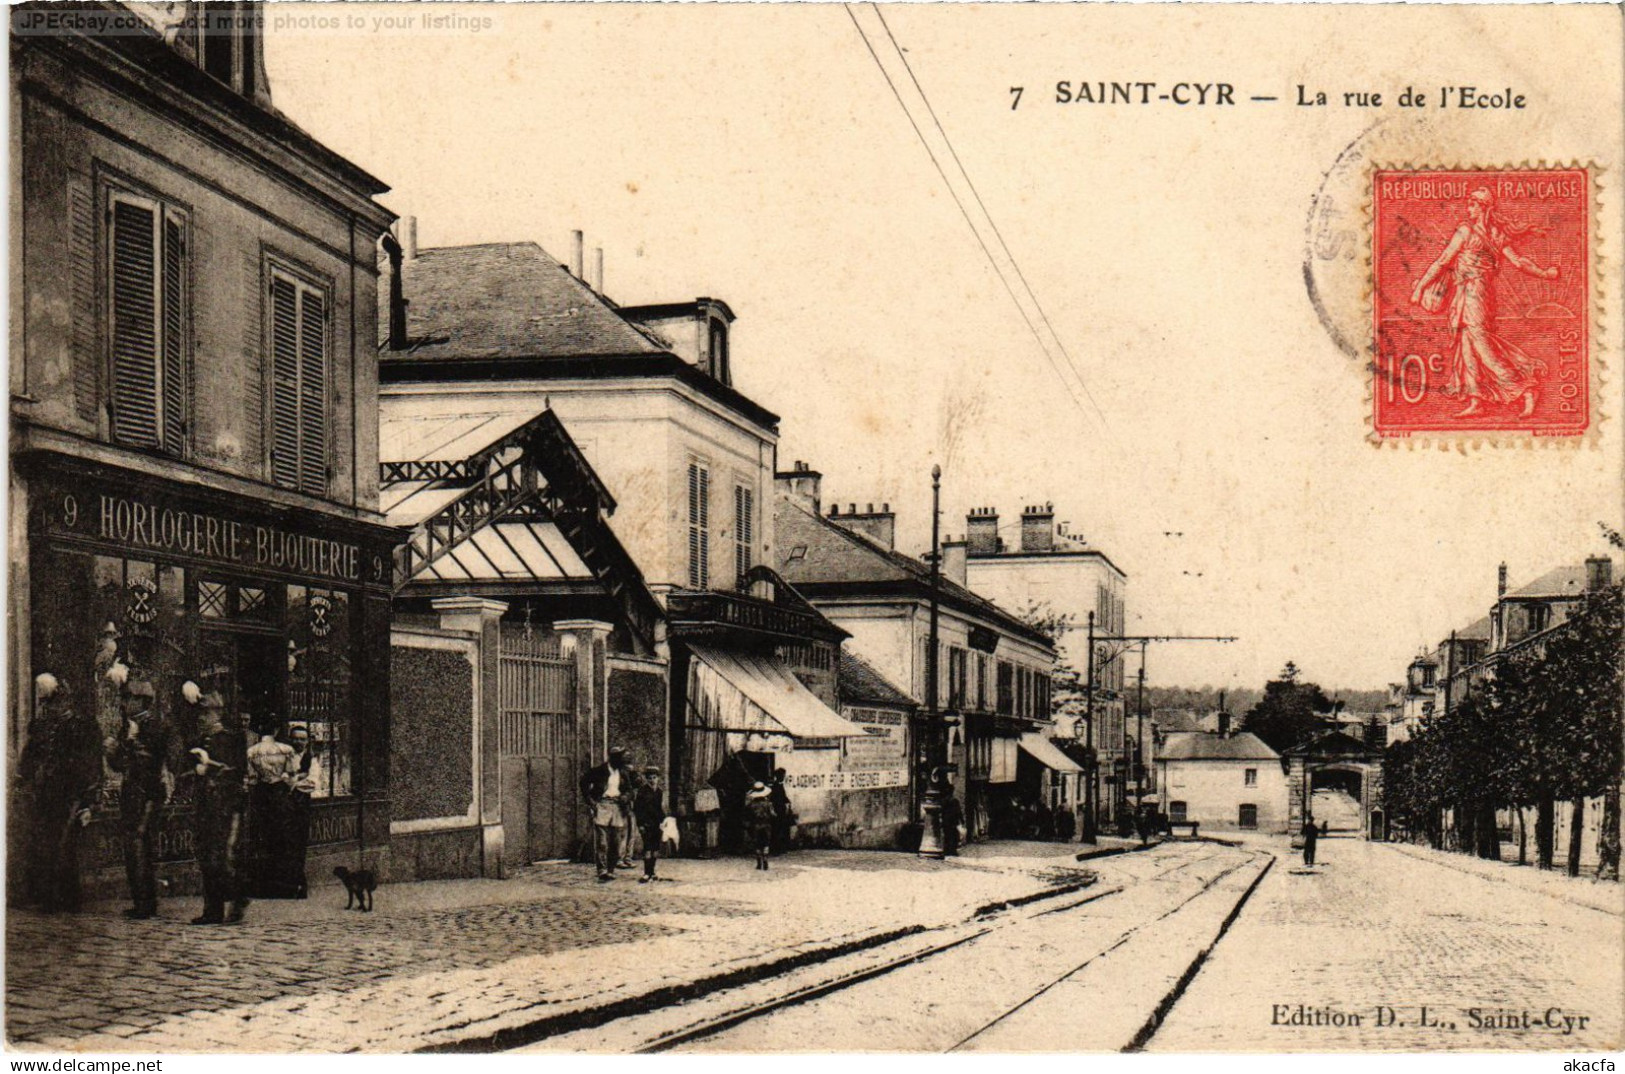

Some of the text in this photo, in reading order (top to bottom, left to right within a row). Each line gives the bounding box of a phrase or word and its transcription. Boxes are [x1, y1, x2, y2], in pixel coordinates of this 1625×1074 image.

[1009, 87, 1024, 111] 7
[1055, 81, 1236, 105] SAINT-CYR
[1297, 84, 1328, 107] La
[1343, 91, 1383, 107] rue
[1397, 86, 1426, 108] de
[1439, 86, 1527, 109] l'Ecole
[1559, 329, 1579, 413] POSTES
[63, 495, 384, 581] 9 HORLOGERIE BIJOUTERIE 9
[1271, 1004, 1364, 1026] Edition
[1374, 1006, 1405, 1027] D.
[1468, 1007, 1590, 1035] Saint-Cyr
